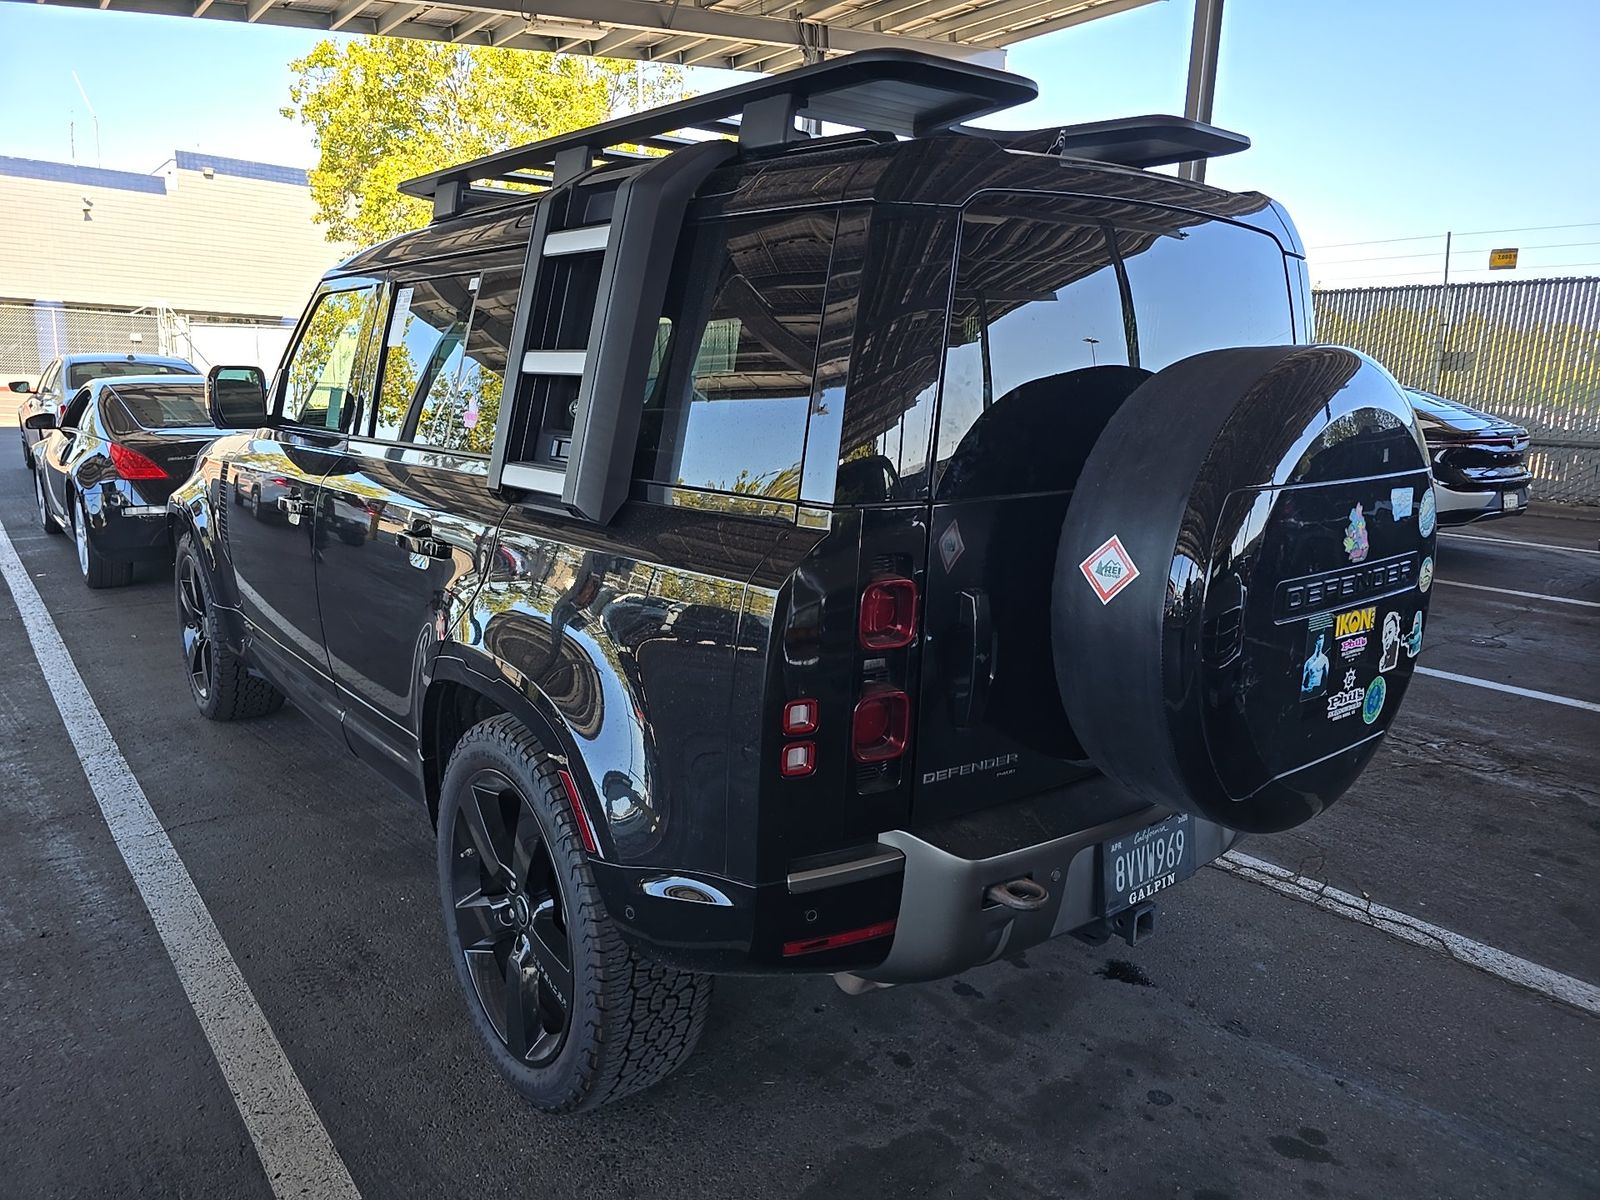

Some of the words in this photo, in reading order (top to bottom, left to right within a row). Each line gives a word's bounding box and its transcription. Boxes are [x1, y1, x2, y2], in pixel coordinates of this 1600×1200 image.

[1105, 566, 1121, 575] REI
[1287, 561, 1411, 608] DEFENDER
[1335, 608, 1372, 637] IKON
[923, 753, 1018, 784] DEFENDER
[1115, 829, 1185, 892] 8VVW969
[1128, 872, 1176, 905] GALPIN
